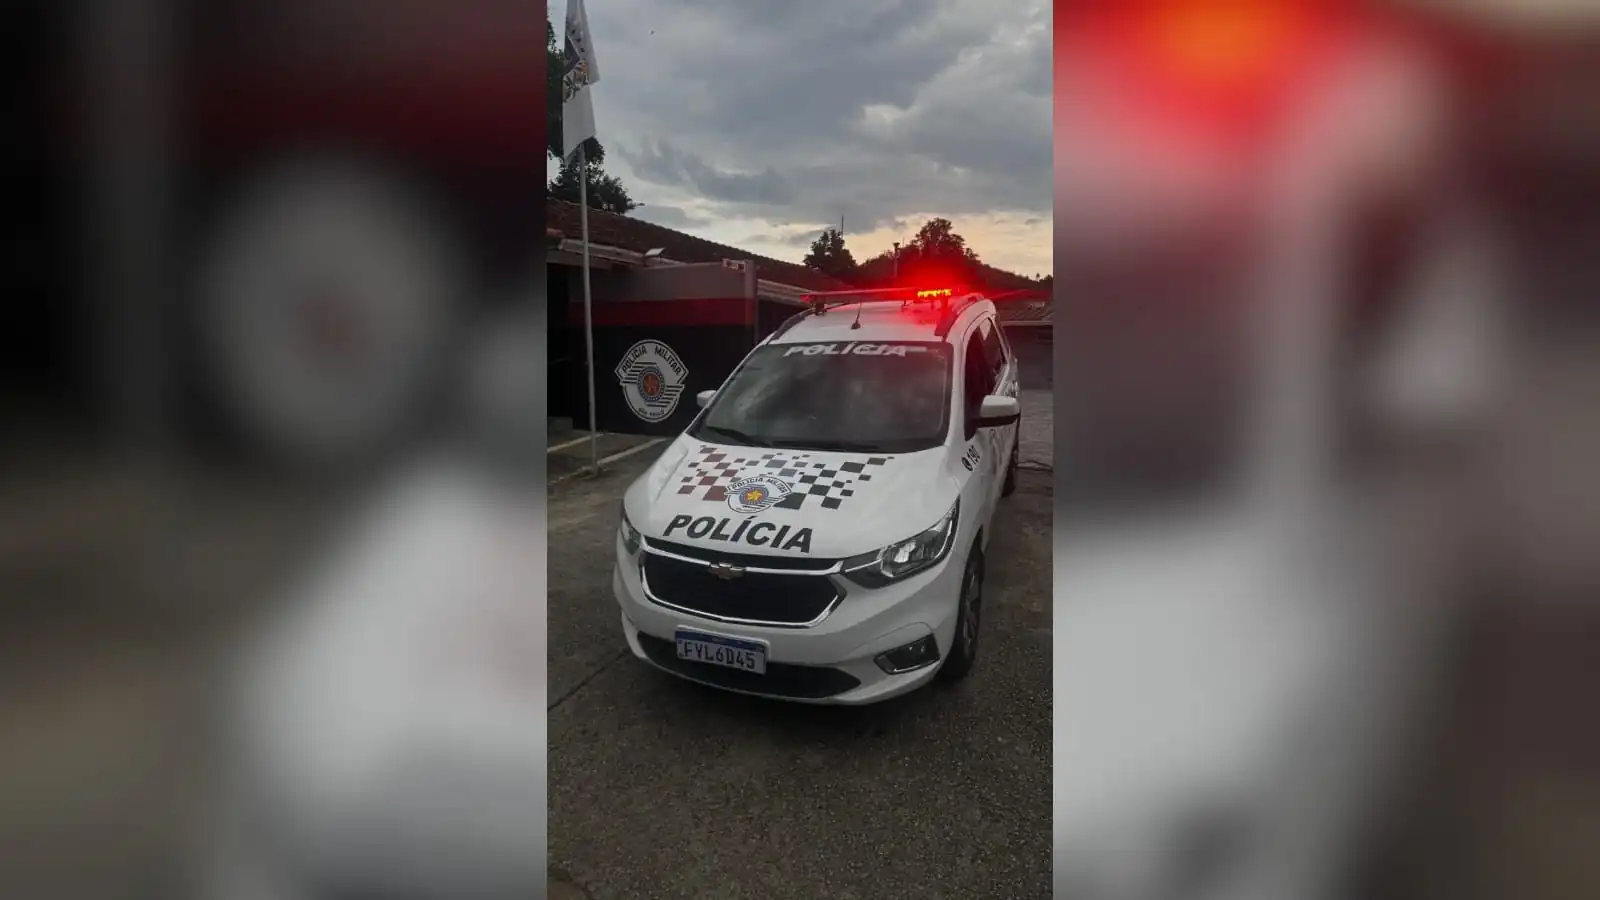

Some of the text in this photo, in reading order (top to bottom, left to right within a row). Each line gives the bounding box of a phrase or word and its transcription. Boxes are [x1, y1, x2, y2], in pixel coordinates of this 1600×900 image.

[654, 345, 682, 375] MILITAR
[782, 341, 906, 357] POLÍCIA
[662, 515, 813, 553] POLÍCIA
[684, 640, 755, 669] FYL6D45
